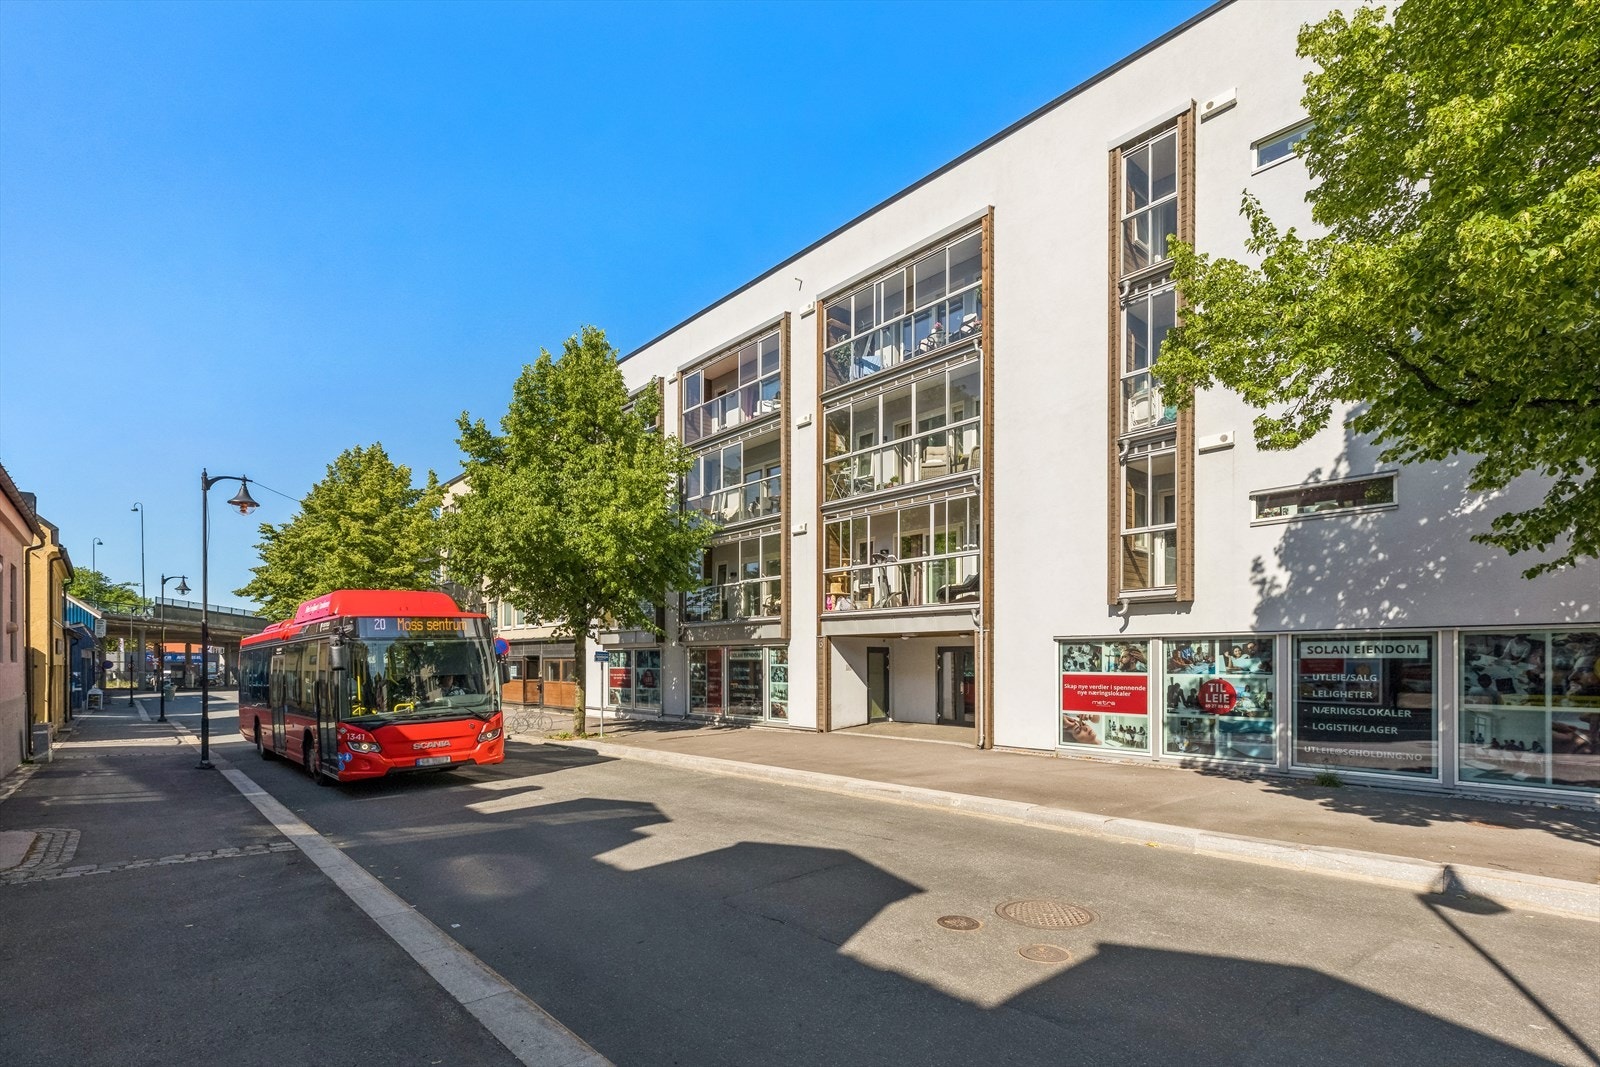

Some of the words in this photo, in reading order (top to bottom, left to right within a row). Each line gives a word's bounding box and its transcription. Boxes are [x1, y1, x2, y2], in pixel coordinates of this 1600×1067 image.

[374, 618, 386, 630] 20
[397, 617, 423, 631] Moss
[426, 617, 467, 631] sentrum
[1307, 645, 1350, 655] SOLAN
[1354, 644, 1420, 654] EIENDOM
[1312, 673, 1377, 682] UTLEIE/SALG
[1208, 683, 1226, 692] TIL
[1205, 693, 1230, 703] LEIE
[1312, 690, 1373, 699] LELIGHETER
[1312, 706, 1412, 718] NÆRINGSLOKALER
[1312, 722, 1398, 735] LOGISTIK/LAGER
[412, 740, 451, 750] SCANIA
